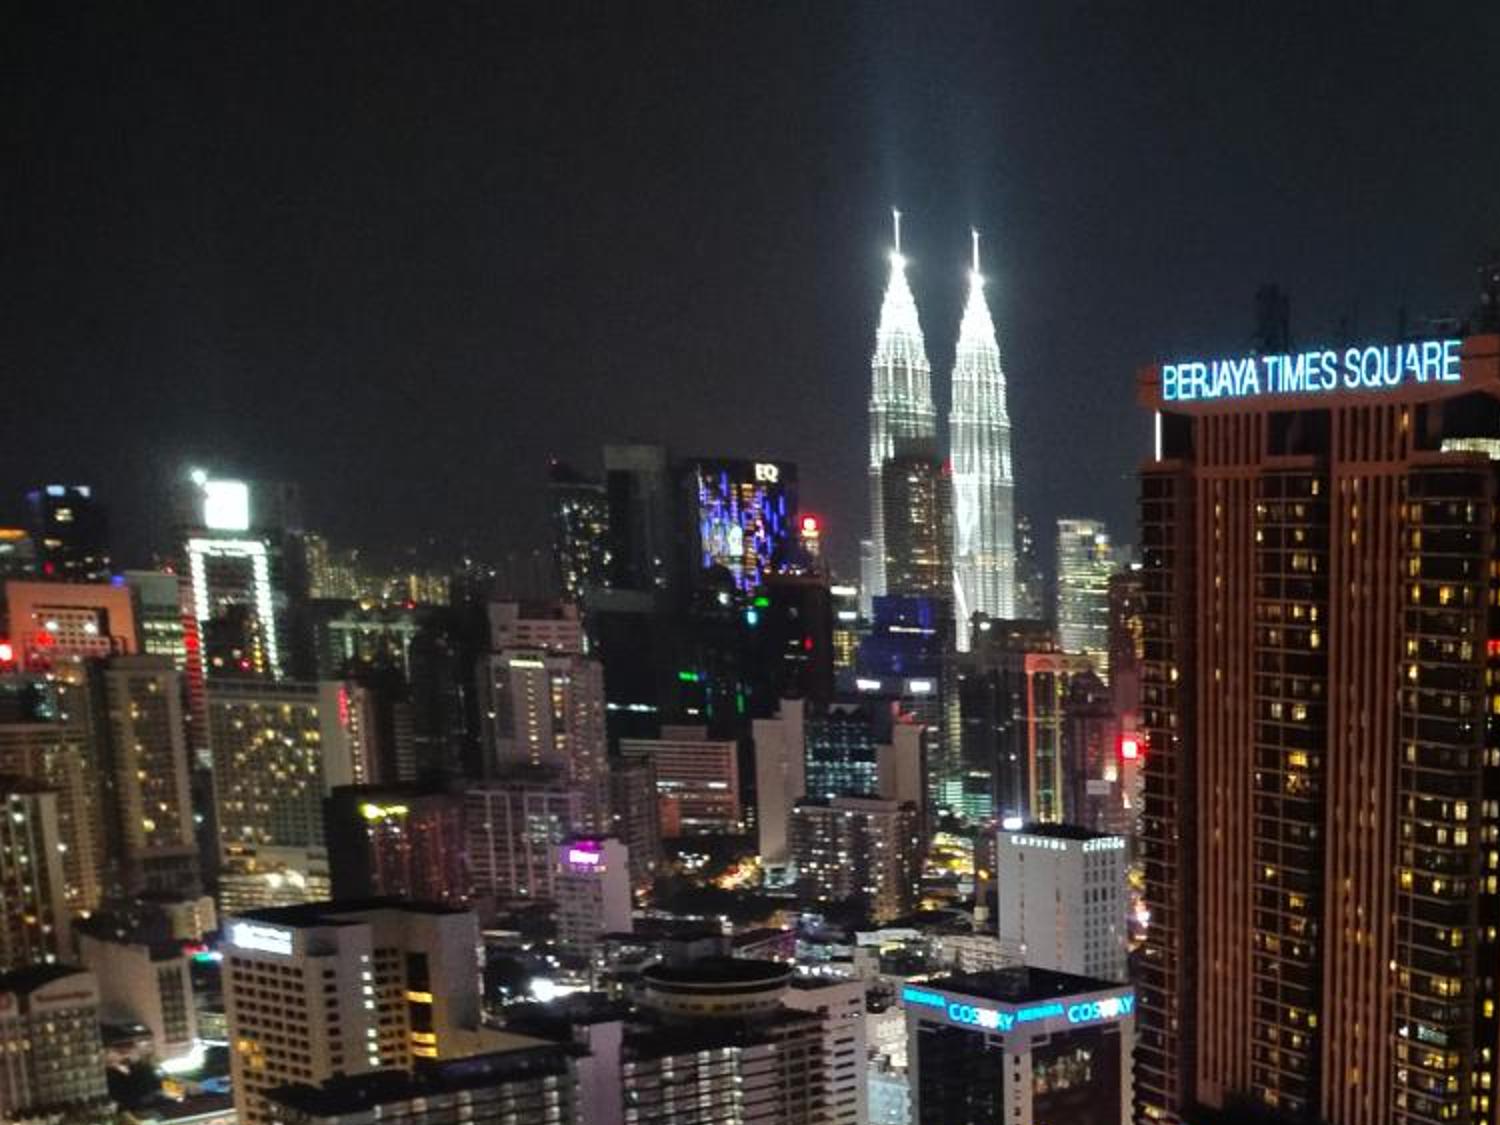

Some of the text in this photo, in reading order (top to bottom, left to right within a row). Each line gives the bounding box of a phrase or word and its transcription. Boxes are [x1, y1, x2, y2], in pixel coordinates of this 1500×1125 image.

[1163, 339, 1462, 400] BERJAYA TIMES SQUARE
